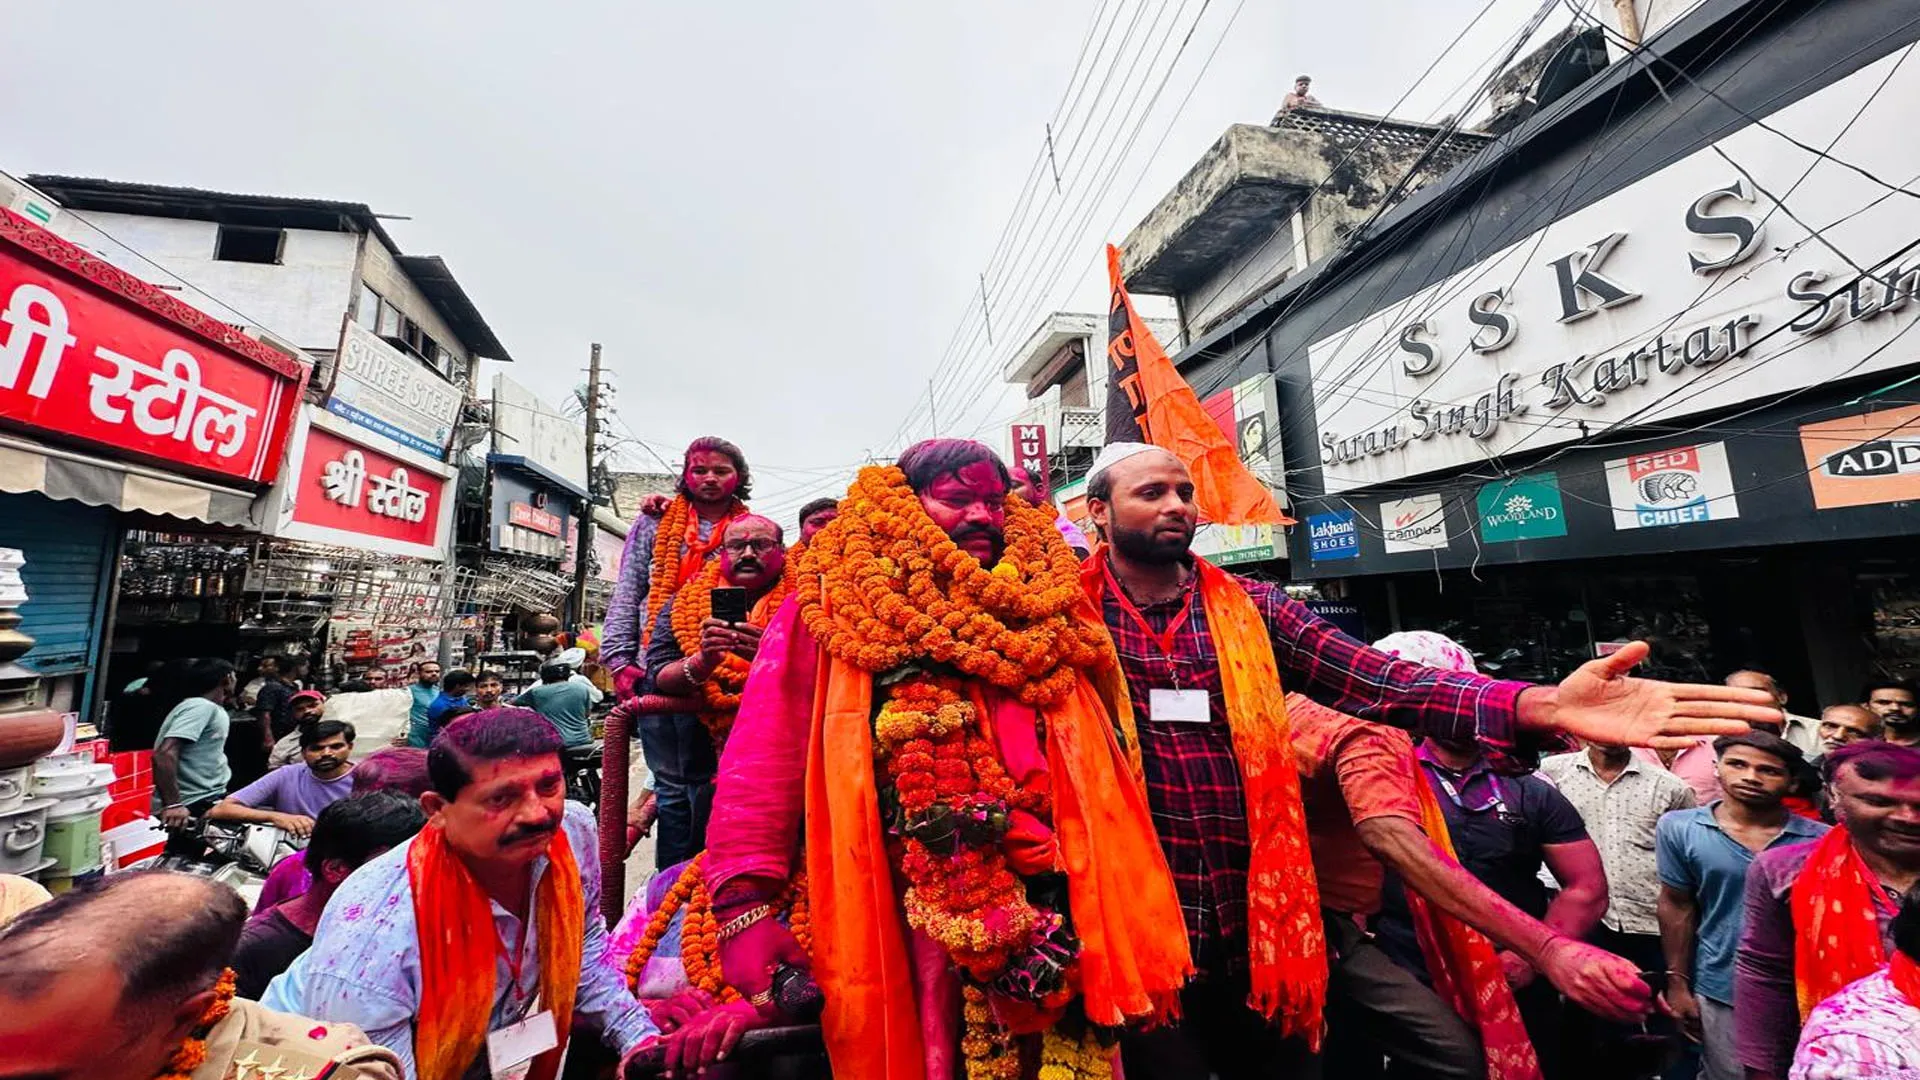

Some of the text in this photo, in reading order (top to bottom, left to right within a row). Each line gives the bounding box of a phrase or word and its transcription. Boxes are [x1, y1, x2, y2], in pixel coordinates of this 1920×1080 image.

[344, 338, 457, 423] SHREE STEEL
[1321, 423, 1404, 465] Saran
[1409, 373, 1528, 440] Singh
[1541, 313, 1761, 407] Kartar
[89, 346, 256, 457] स्टील
[1635, 451, 1689, 473] RED
[320, 450, 430, 523] श्री स्टील
[1486, 506, 1557, 527] WOODLAND
[1639, 504, 1706, 526] CHIEF
[1312, 536, 1355, 550] SHOES
[1311, 606, 1358, 614] ABROS
